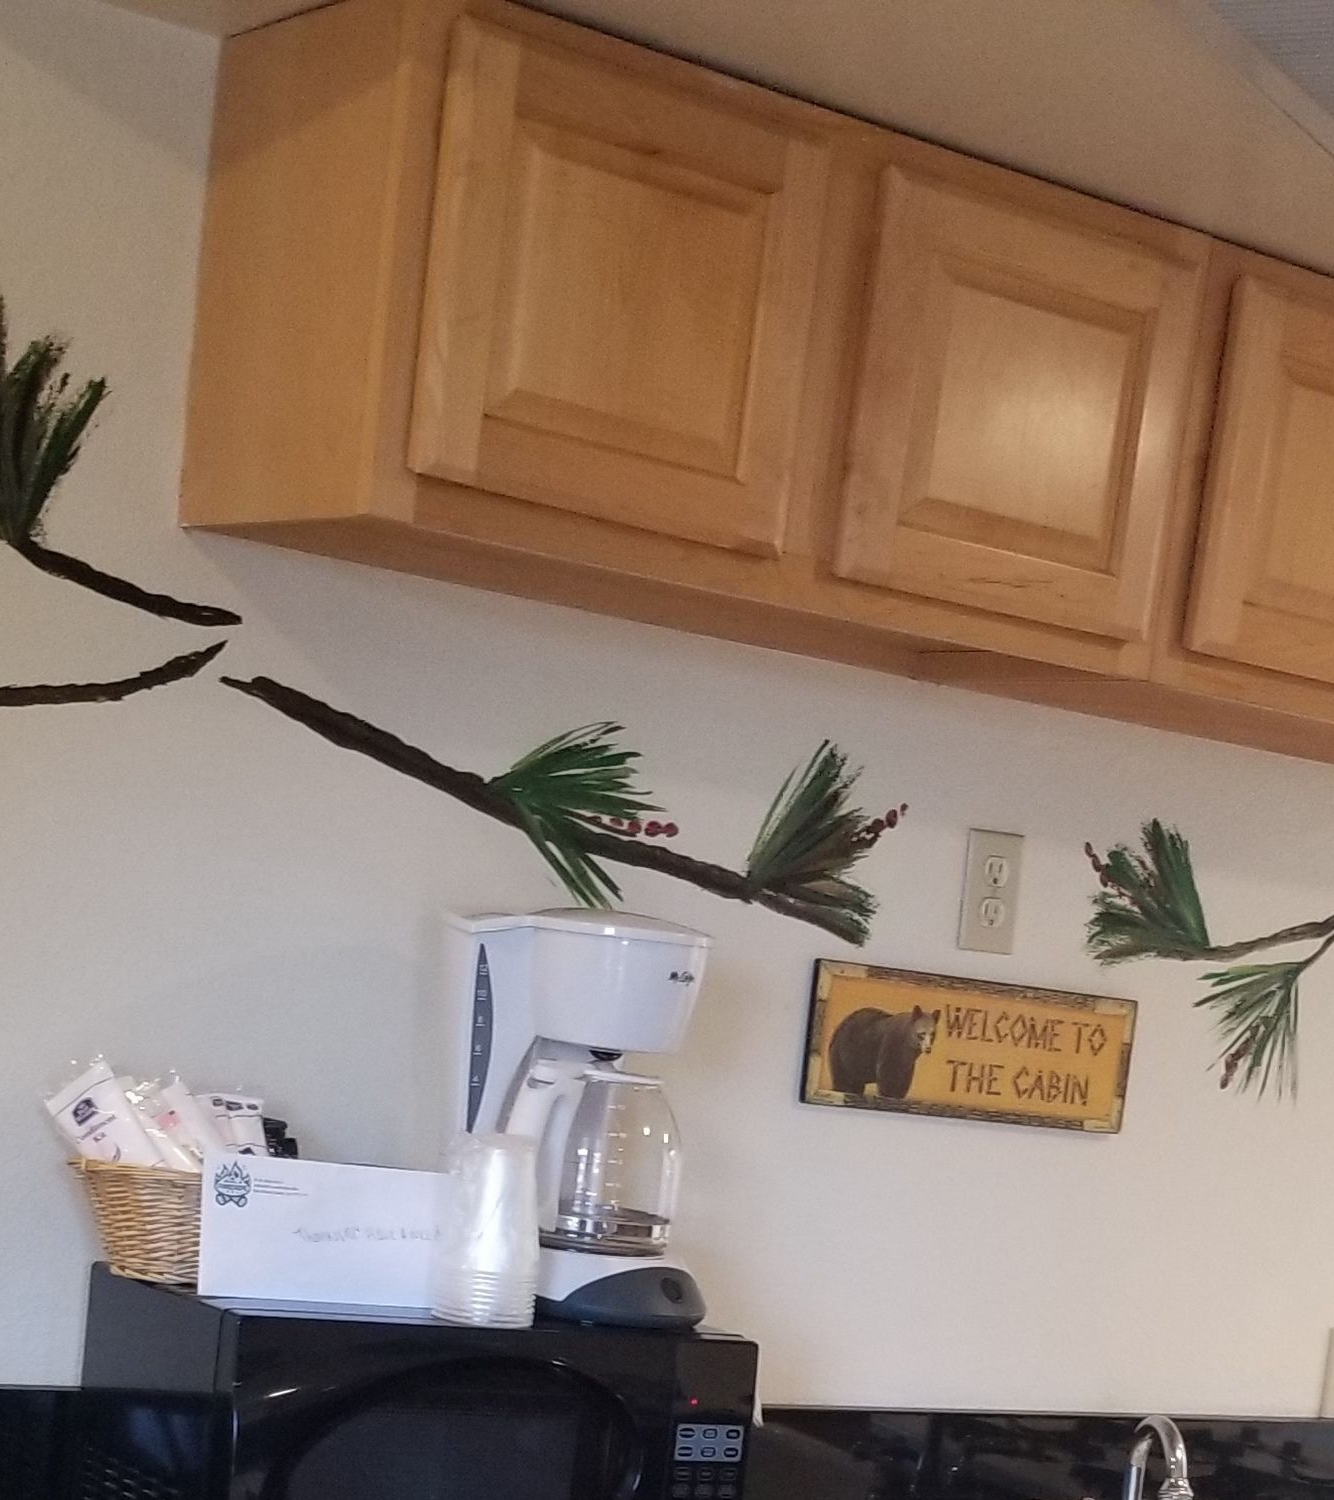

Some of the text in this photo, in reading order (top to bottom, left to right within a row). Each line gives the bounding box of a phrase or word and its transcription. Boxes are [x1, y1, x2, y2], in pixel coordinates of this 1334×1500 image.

[945, 1003, 1107, 1056] WELCOME TO
[946, 1059, 1089, 1106] THE CABIN
